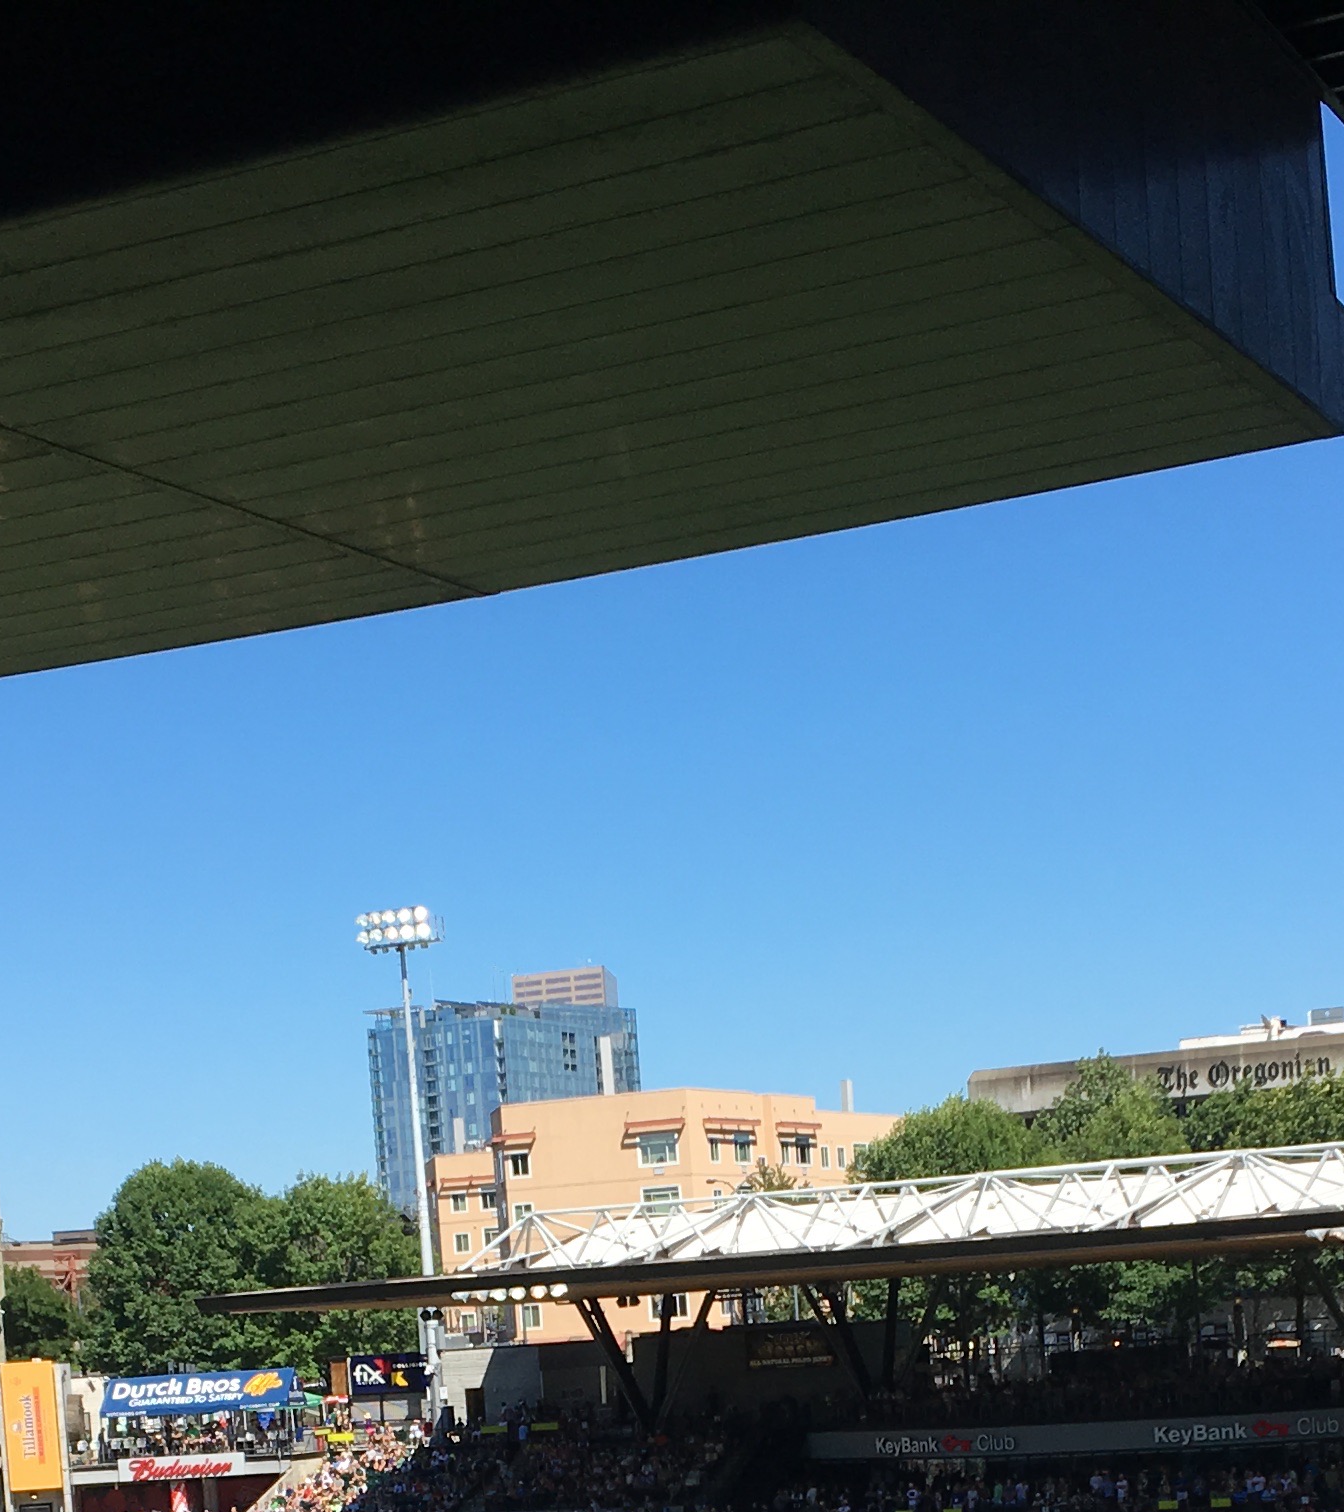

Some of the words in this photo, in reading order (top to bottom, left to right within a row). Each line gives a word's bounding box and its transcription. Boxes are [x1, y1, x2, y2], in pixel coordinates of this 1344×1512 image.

[1158, 1064, 1199, 1093] The
[186, 1377, 242, 1396] BROS
[18, 1393, 37, 1460] Tillamook
[1153, 1422, 1248, 1446] KeyBank
[1297, 1416, 1340, 1436] Club
[874, 1436, 939, 1457] KeyBank
[976, 1434, 1016, 1452] Club
[128, 1456, 234, 1483] Budweiser
